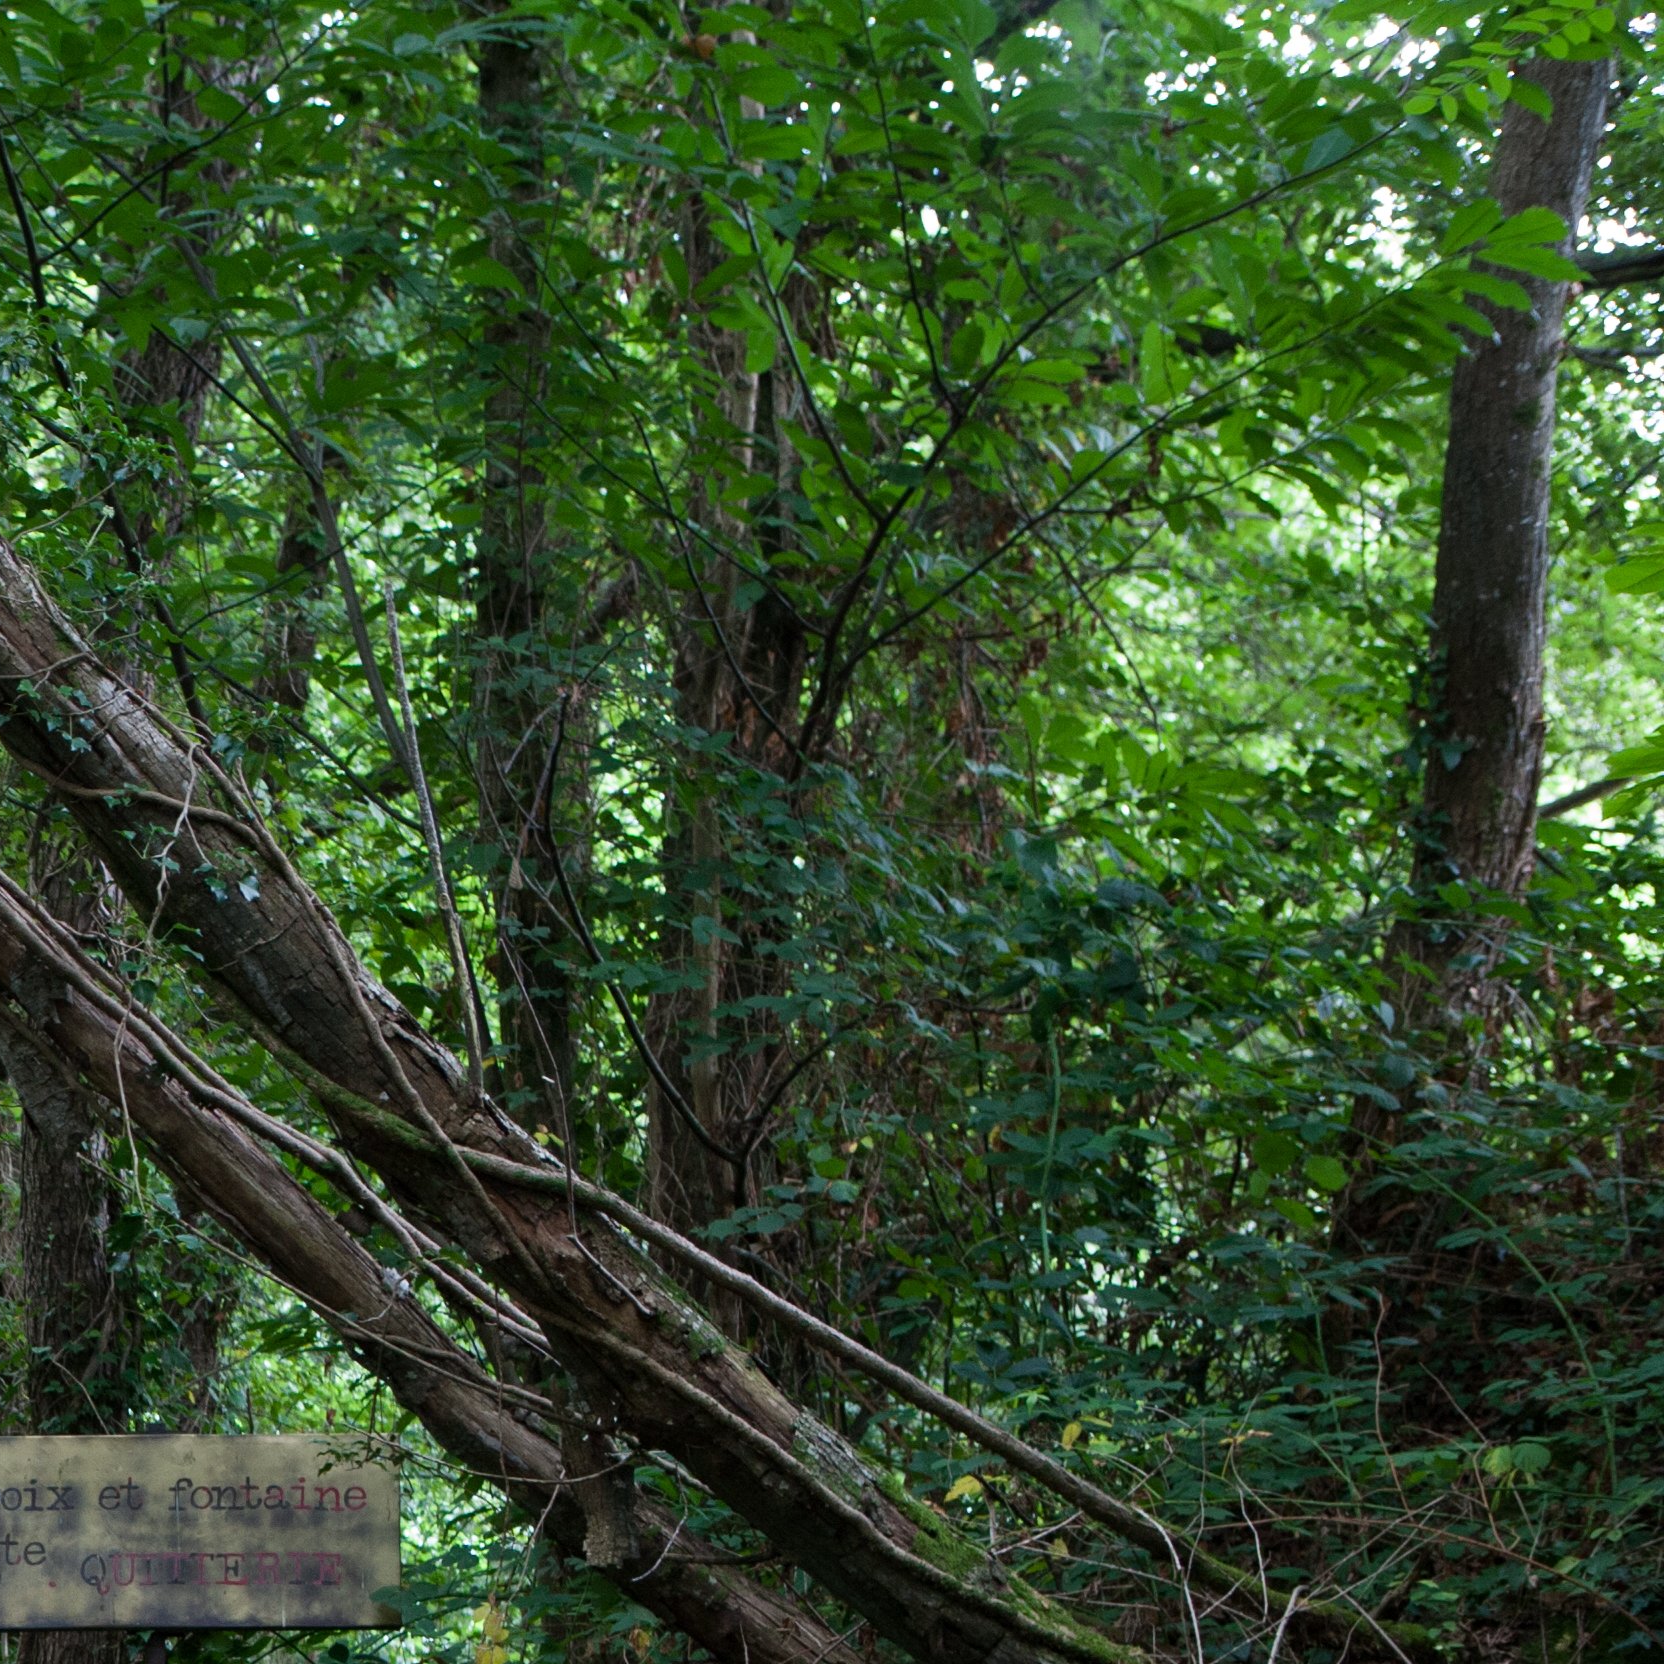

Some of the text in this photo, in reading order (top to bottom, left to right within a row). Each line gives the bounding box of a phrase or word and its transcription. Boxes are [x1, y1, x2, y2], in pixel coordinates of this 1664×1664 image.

[98, 1476, 144, 1511] et
[168, 1475, 368, 1512] fontaine
[80, 1552, 343, 1595] QUITTERIE
